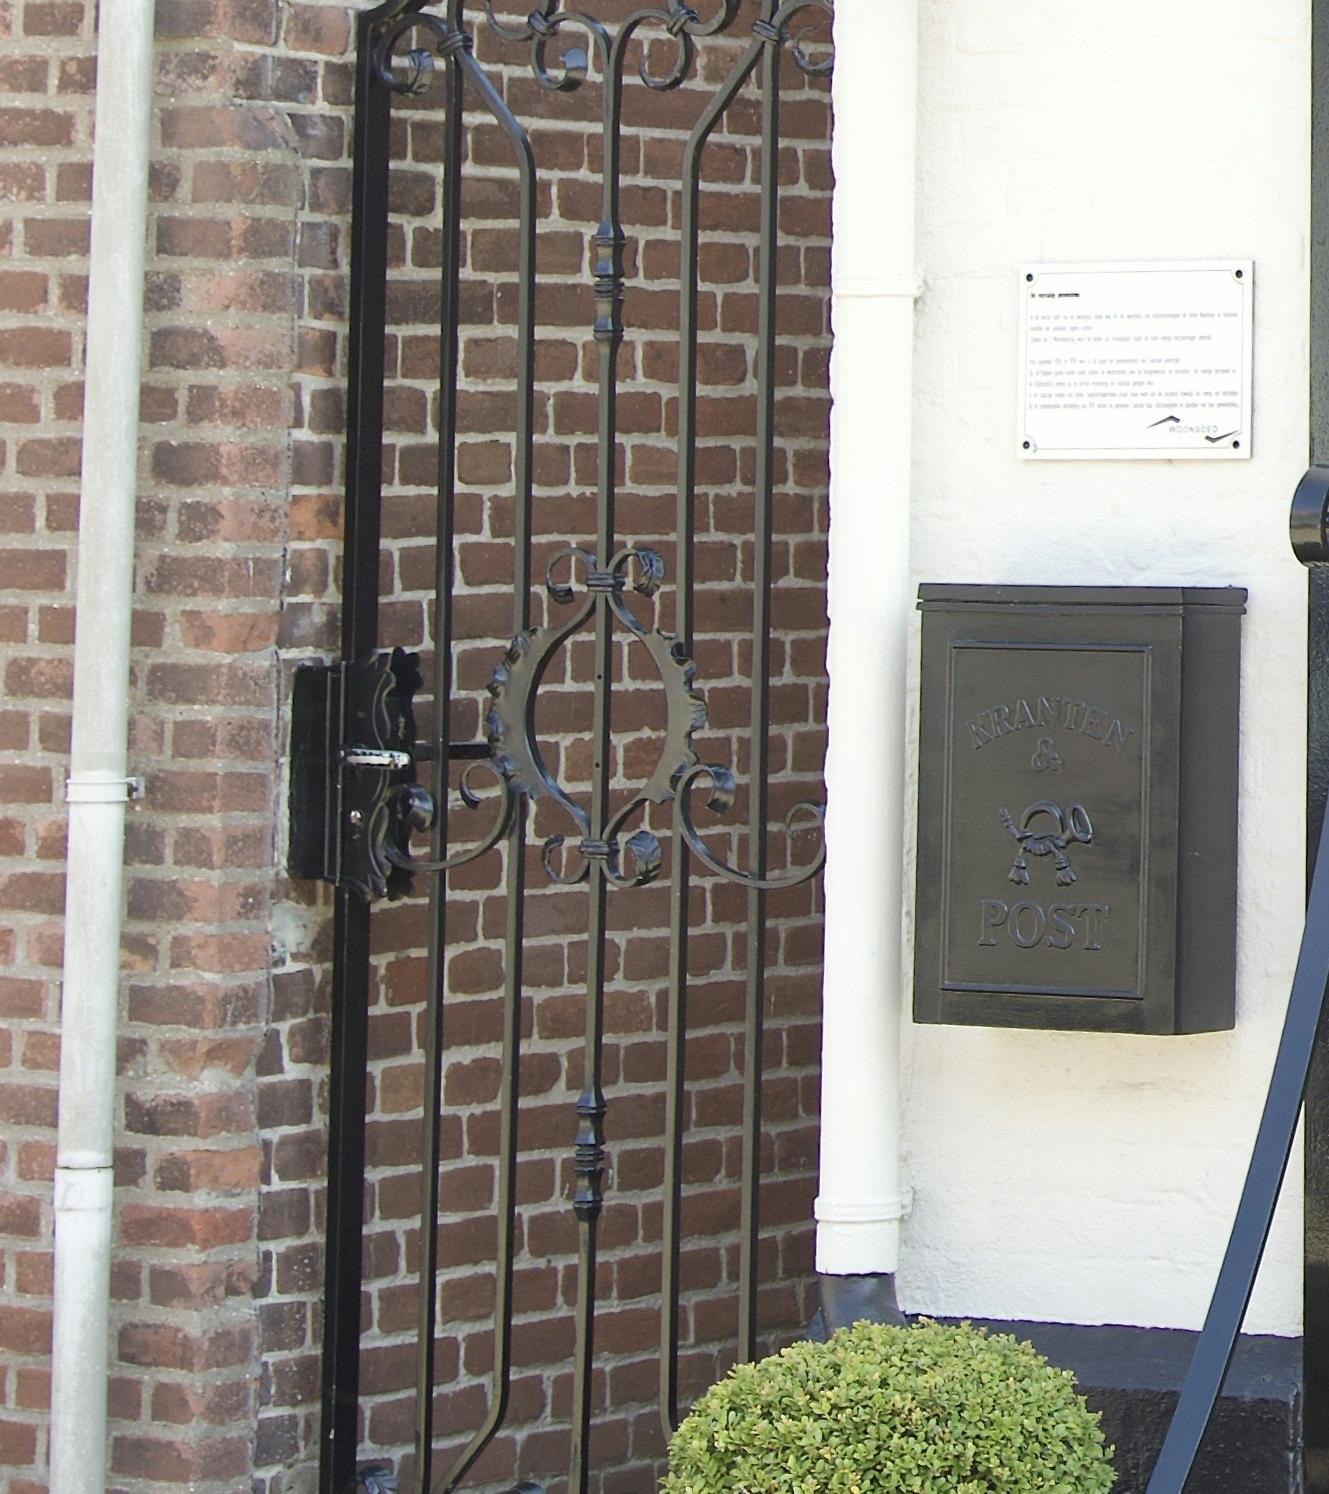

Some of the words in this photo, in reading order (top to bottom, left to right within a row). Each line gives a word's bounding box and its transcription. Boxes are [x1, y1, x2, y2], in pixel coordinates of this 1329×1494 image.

[966, 696, 1133, 754] KRANTEN
[1031, 736, 1063, 773] &
[976, 899, 1110, 950] POST
